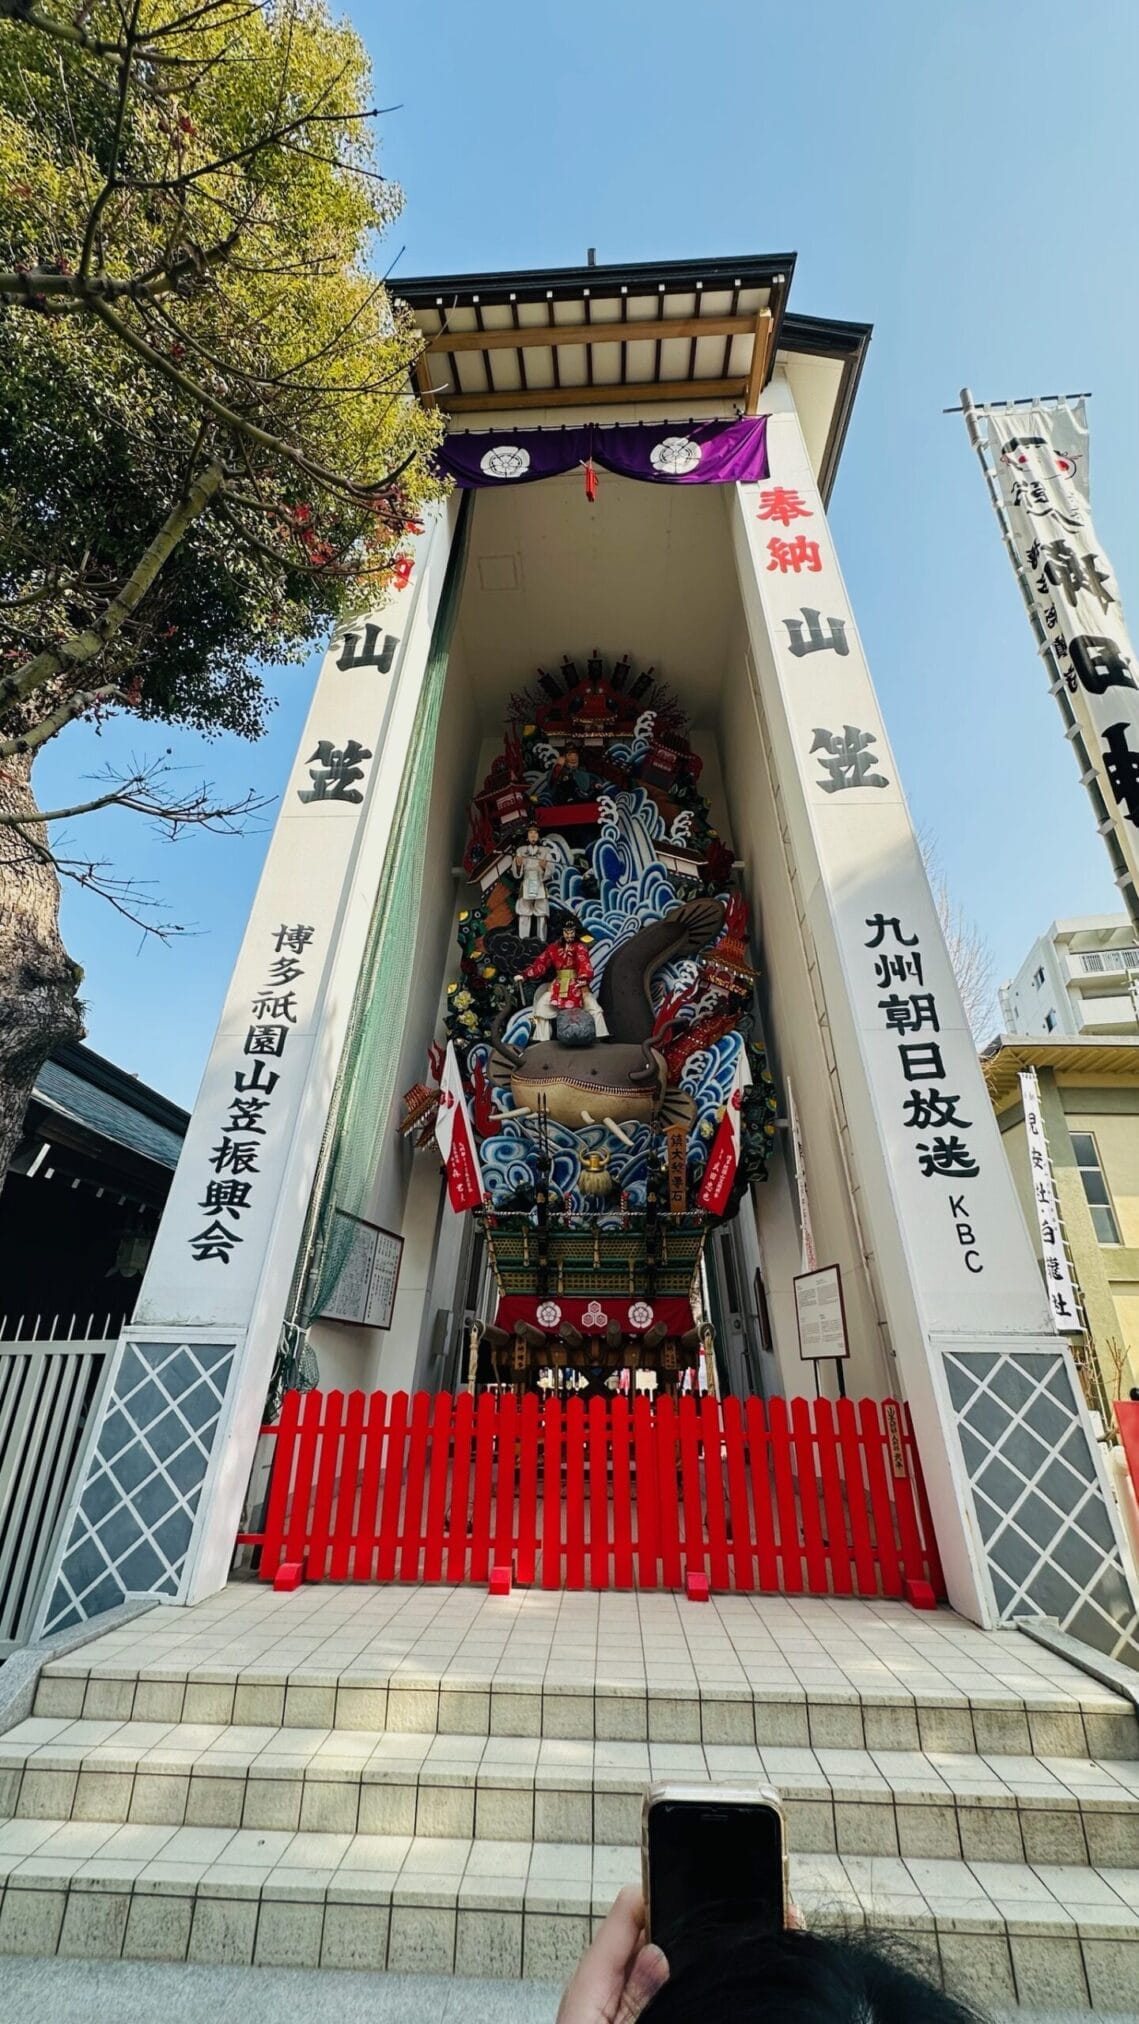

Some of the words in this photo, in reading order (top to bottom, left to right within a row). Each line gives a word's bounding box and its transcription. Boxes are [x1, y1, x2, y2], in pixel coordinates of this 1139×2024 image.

[757, 486, 823, 573] 奉納
[297, 622, 400, 804] 山笠
[782, 607, 890, 794] 山笠
[188, 924, 315, 1265] 博多祇園山笠振興会
[864, 913, 980, 1178] 九州朝日放送
[948, 1195, 984, 1274] KBC
